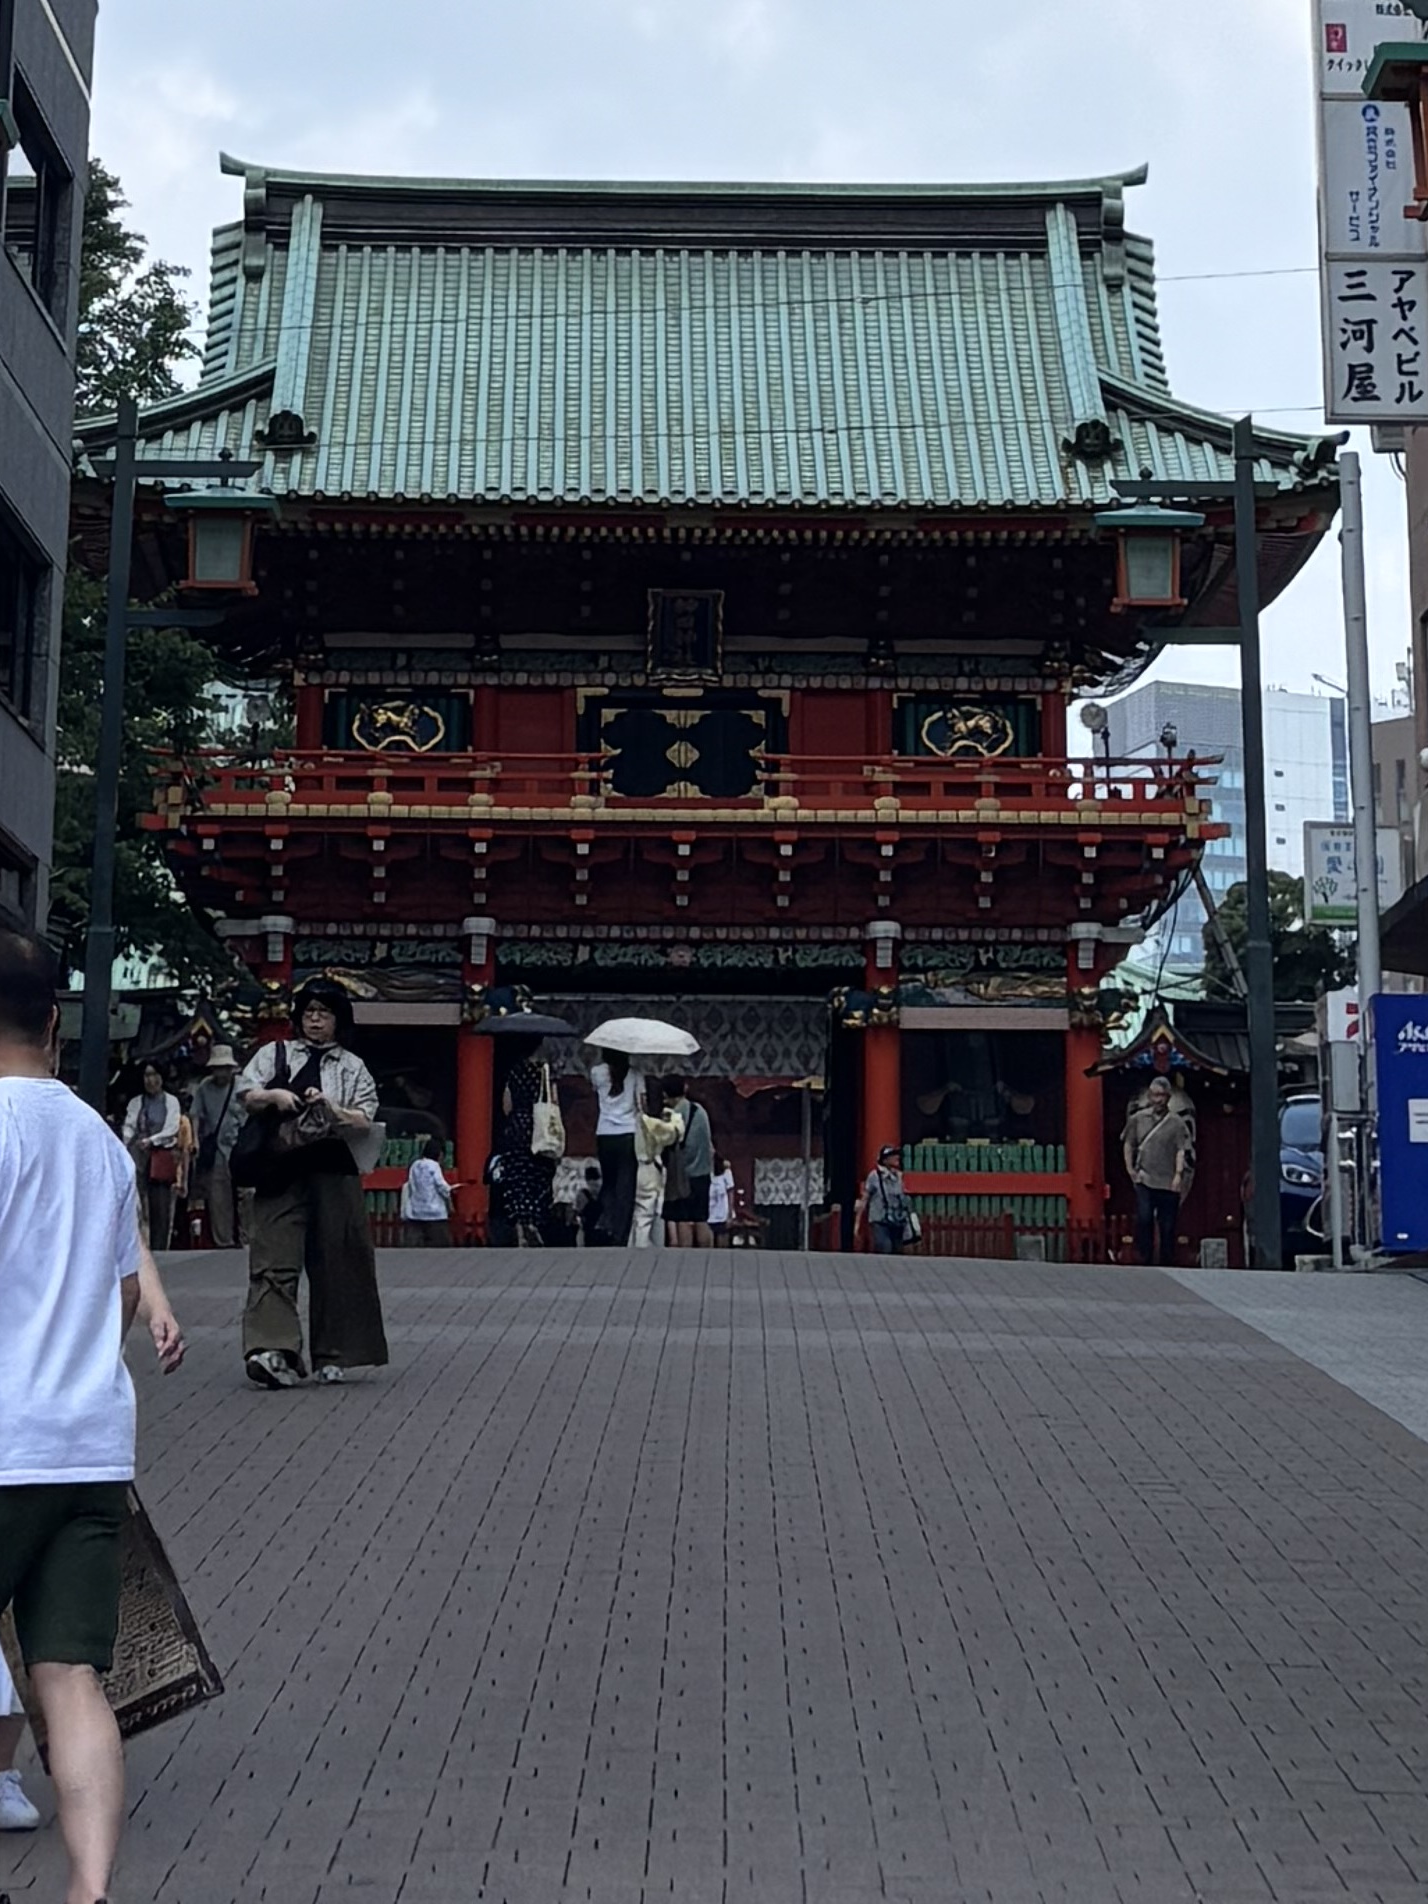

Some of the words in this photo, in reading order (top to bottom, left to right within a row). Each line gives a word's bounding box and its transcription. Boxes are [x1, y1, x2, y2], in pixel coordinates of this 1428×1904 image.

[1338, 270, 1382, 405] 三河屋
[1390, 270, 1424, 405] アヤベビル
